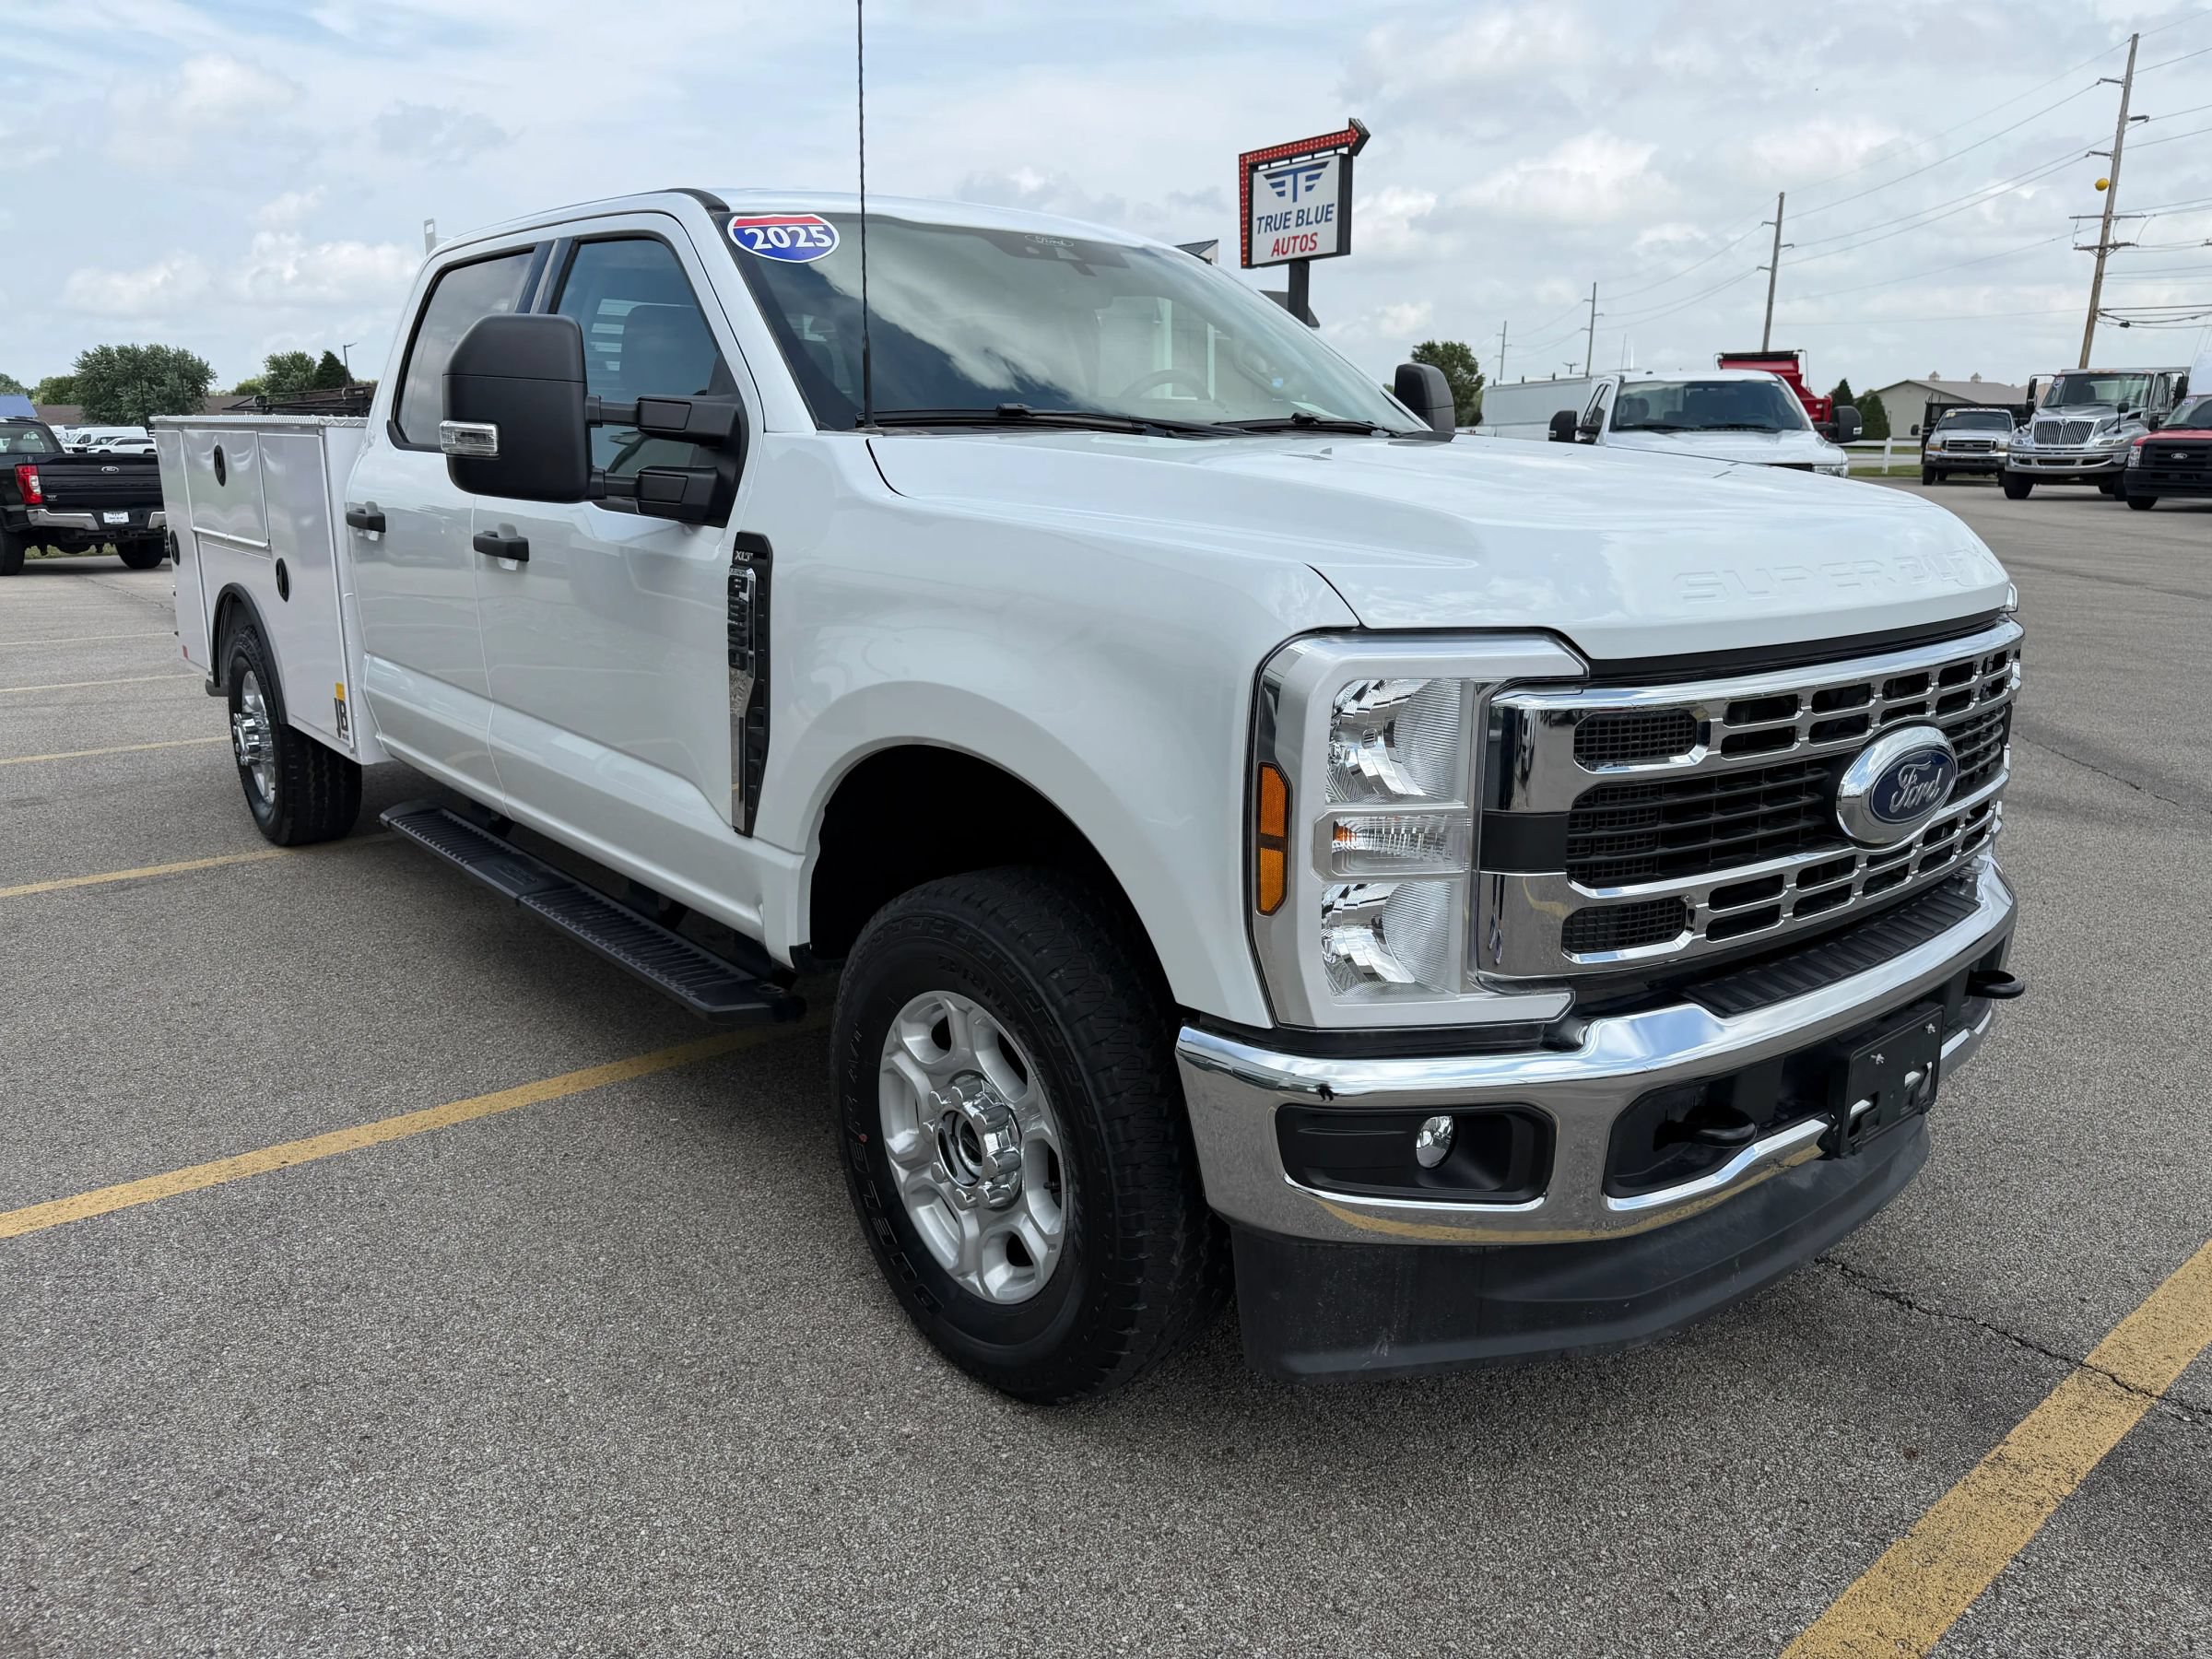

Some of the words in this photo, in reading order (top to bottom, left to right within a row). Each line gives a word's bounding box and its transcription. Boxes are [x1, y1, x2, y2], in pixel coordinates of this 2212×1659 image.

[1256, 211, 1292, 234] TRUE
[1295, 203, 1335, 228] BLUE
[744, 226, 833, 250] 2025
[1271, 232, 1318, 257] AUTOS
[735, 550, 754, 562] XLT
[1889, 760, 1944, 814] Ford
